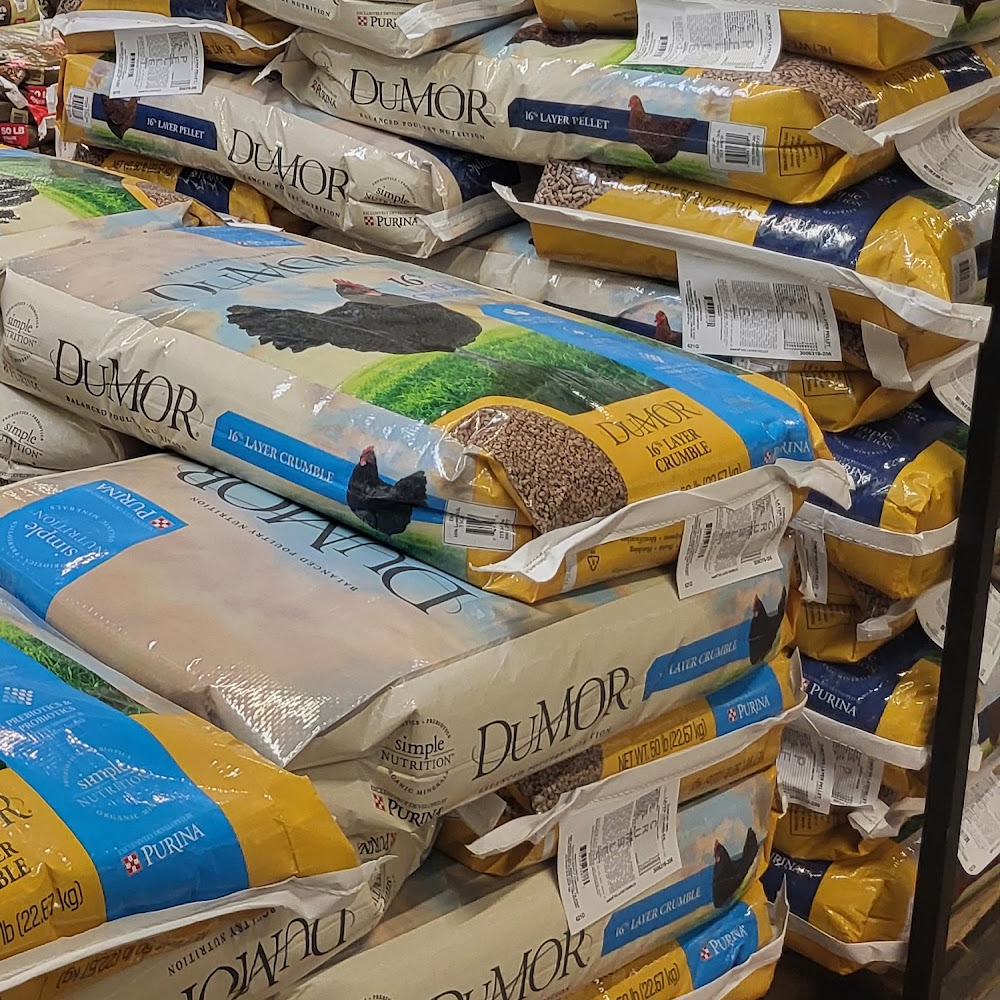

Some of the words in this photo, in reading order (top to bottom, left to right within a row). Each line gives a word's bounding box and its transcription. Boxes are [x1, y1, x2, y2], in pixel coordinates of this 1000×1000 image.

[291, 0, 332, 18] NUTRITION
[1, 126, 13, 135] 50
[13, 127, 25, 136] LB
[157, 120, 178, 134] LAYER
[178, 123, 206, 141] PELLET
[358, 112, 399, 127] BALANCED
[401, 119, 437, 133] POULTRY
[438, 125, 486, 141] NUTRITION
[540, 113, 570, 127] LAYER
[572, 115, 611, 131] PELLET
[374, 185, 411, 206] simple
[376, 215, 419, 229] PURINA
[6, 312, 34, 335] simple
[66, 395, 108, 418] BALANCED
[3, 419, 38, 445] simple
[664, 428, 702, 451] LAYER
[244, 436, 279, 461] LAYER
[279, 451, 336, 483] CRUMBLE
[655, 440, 712, 473] CRUMBLE
[95, 482, 158, 521] PURINA
[189, 496, 249, 531] NUTRITION
[24, 520, 79, 558] simple
[33, 509, 107, 558] NUTRITION
[247, 528, 298, 560] POULTRY
[299, 556, 359, 593] BALANCED
[668, 653, 698, 677] LAYER
[698, 639, 739, 664] CRUMBLE
[737, 694, 771, 721] PURINA
[808, 681, 858, 719] PURINA
[4, 703, 60, 727] PREBIOTICS
[18, 706, 77, 732] PROBIOTICS
[394, 734, 445, 760] simple
[617, 751, 635, 770] NET
[635, 743, 650, 764] WT.
[649, 738, 662, 755] 50
[661, 735, 671, 752] lb
[670, 722, 694, 751] (22.67
[692, 718, 708, 743] kg)
[76, 759, 131, 791] simple
[380, 749, 452, 772] NUTRITION
[76, 771, 155, 807] NUTRITION
[96, 809, 141, 823] ORGANIC
[387, 799, 444, 828] PURINA
[142, 823, 206, 867] PURINA
[0, 921, 15, 947] lb
[16, 896, 58, 939] (22.67
[57, 879, 85, 920] kg)
[630, 910, 660, 933] LAYER
[660, 888, 702, 921] CRUMBLE
[167, 932, 228, 977] NUTRITION
[707, 924, 748, 956] PURINA
[664, 962, 682, 989] kg)
